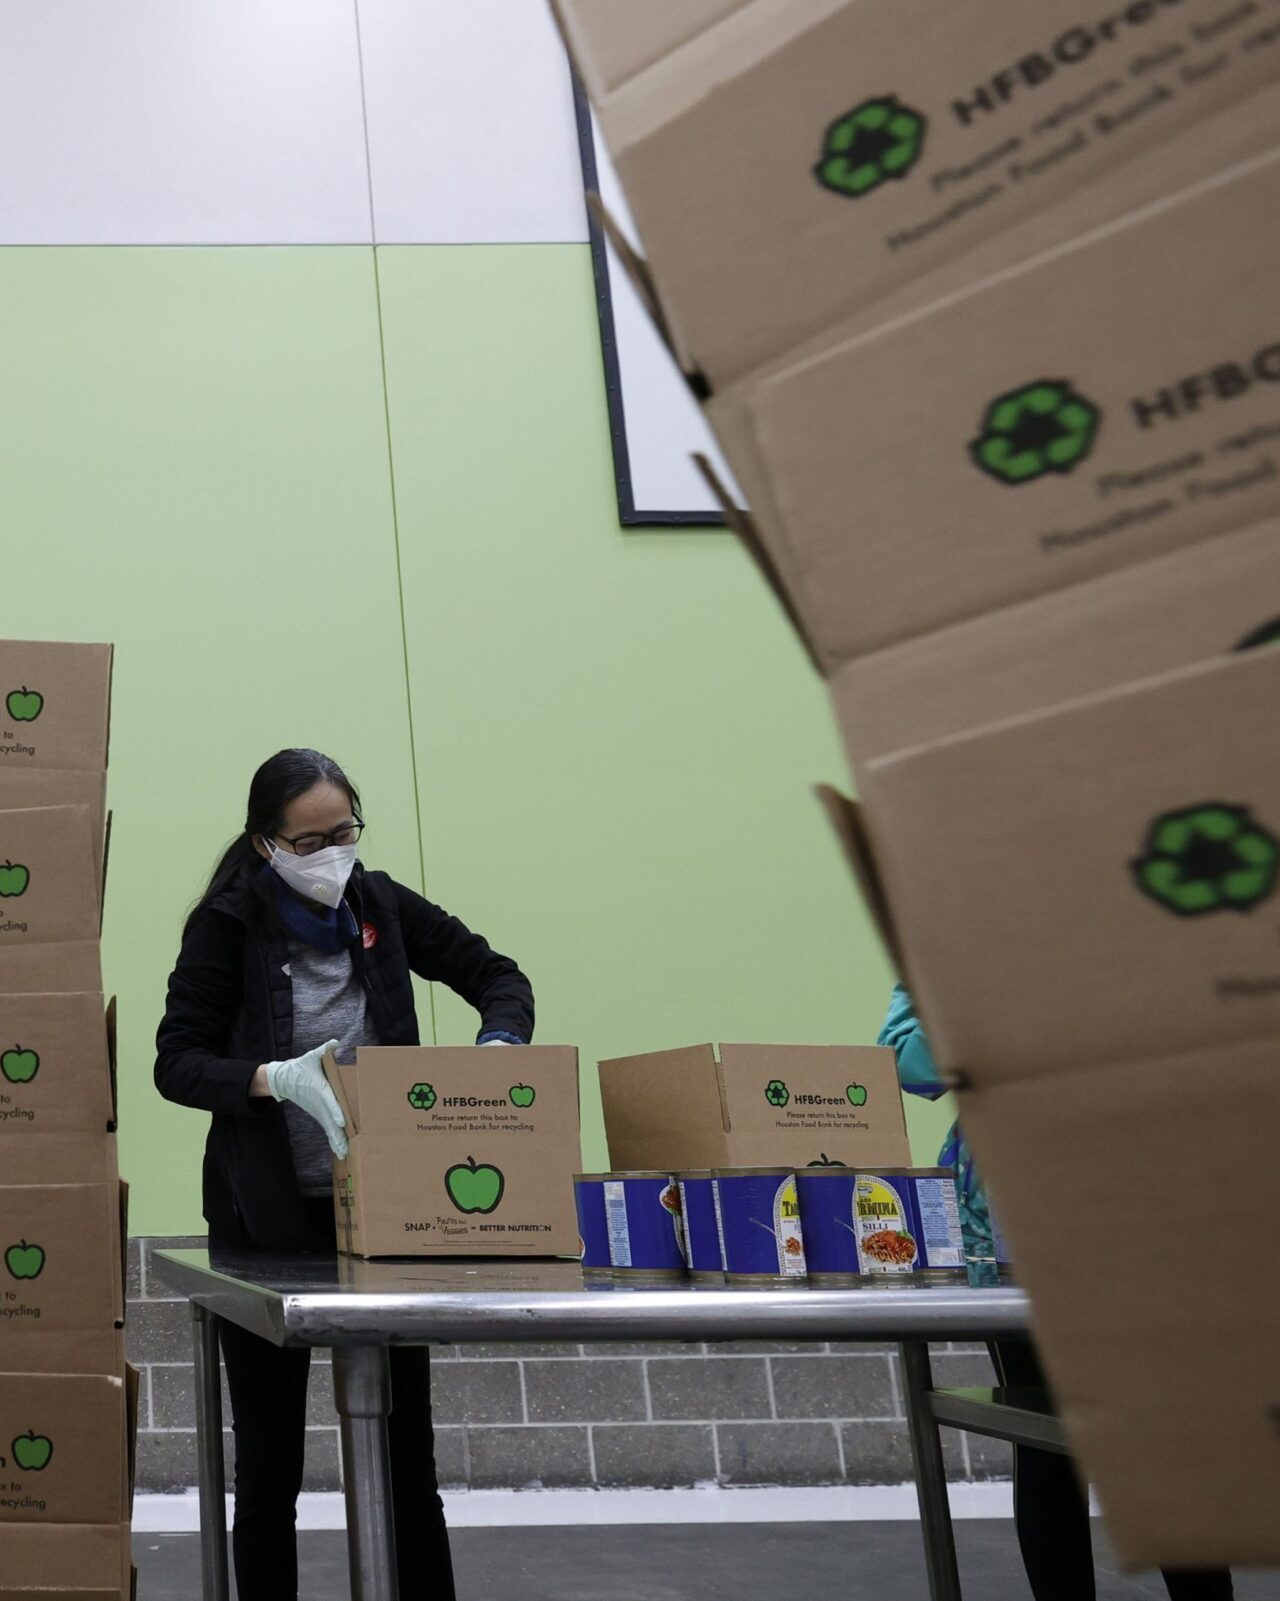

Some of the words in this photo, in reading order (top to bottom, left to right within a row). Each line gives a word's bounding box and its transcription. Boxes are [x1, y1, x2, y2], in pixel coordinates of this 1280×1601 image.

[3, 730, 14, 740] to
[0, 1094, 11, 1104] to
[442, 1096, 507, 1107] HFBGreen
[794, 1094, 846, 1105] HFBGreen
[431, 1113, 455, 1121] Please
[480, 1113, 493, 1121] this
[494, 1113, 508, 1121] box
[448, 1123, 467, 1131] Food
[468, 1122, 487, 1131] Bank
[488, 1122, 500, 1130] for
[501, 1122, 534, 1132] recycling
[404, 1223, 431, 1232] SNAP
[479, 1224, 506, 1232] BETTER
[508, 1224, 552, 1232] NUTRITION
[4, 1290, 17, 1301] to
[10, 1481, 22, 1492] to
